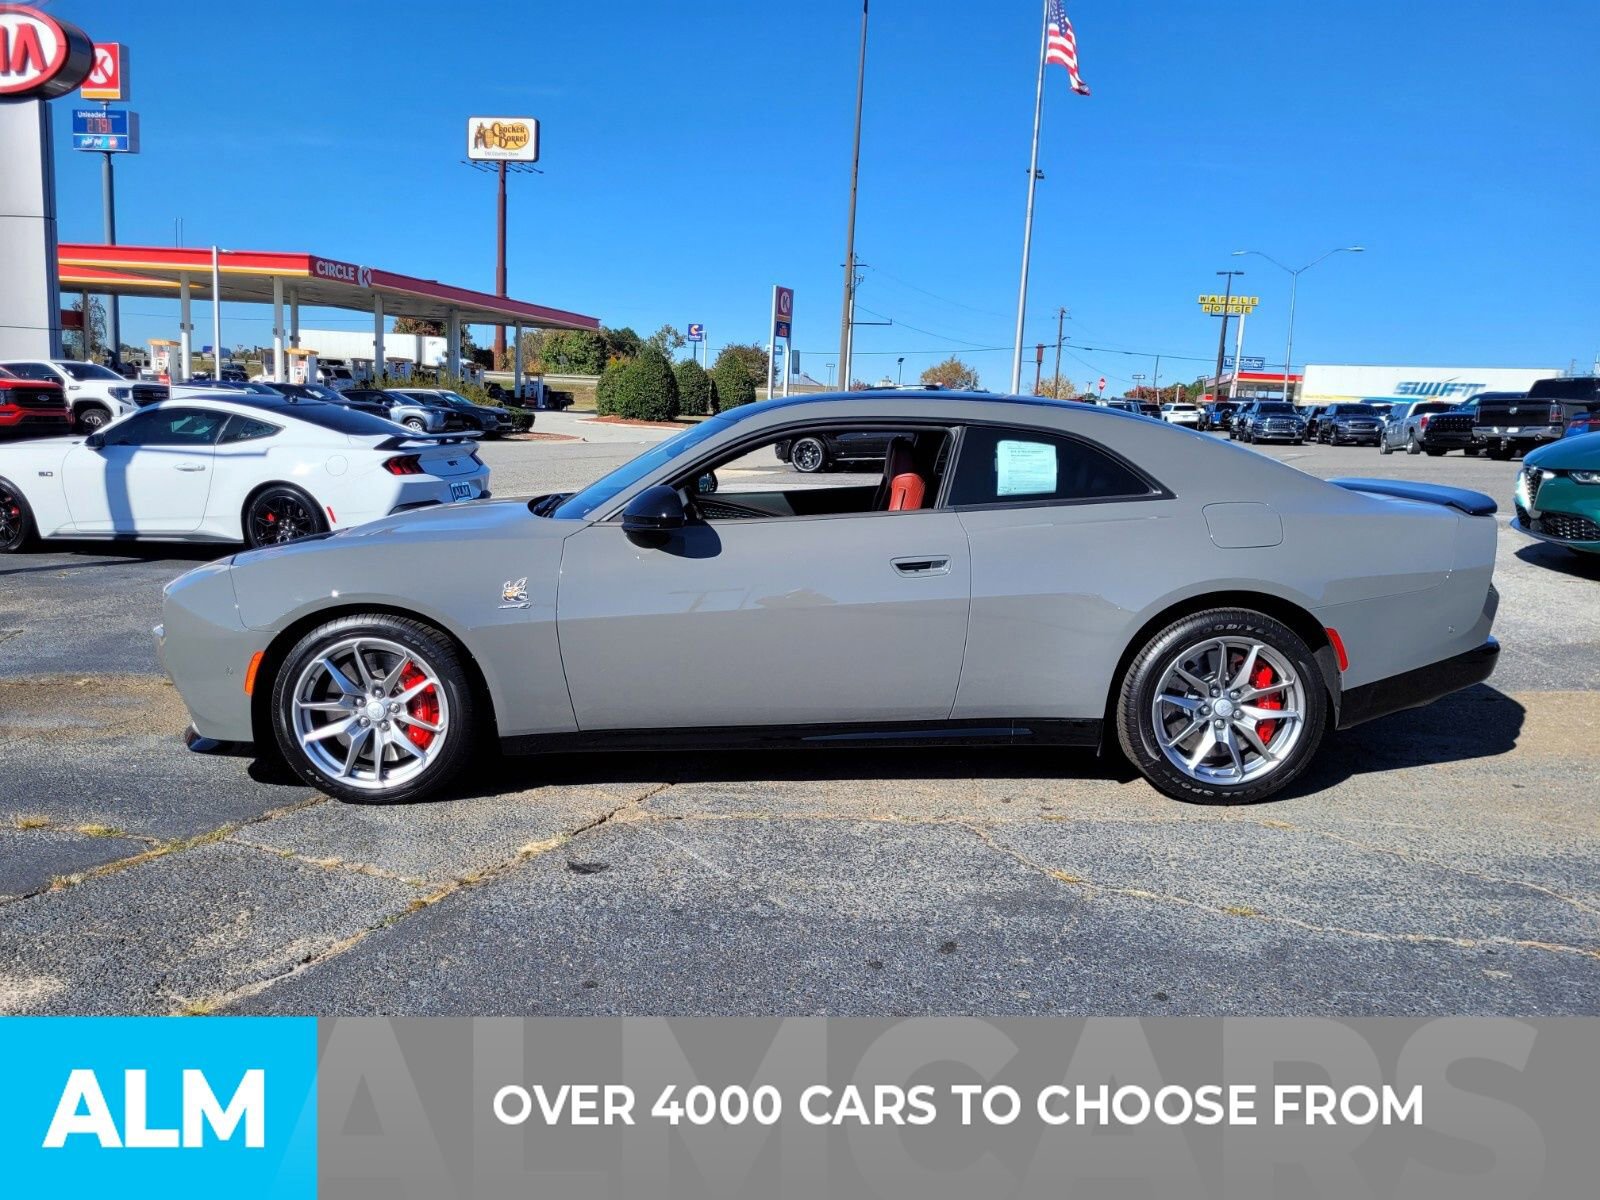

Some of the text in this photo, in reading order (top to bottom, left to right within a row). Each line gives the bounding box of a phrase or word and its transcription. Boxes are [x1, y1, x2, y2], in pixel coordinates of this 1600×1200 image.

[91, 55, 113, 80] K
[316, 260, 355, 281] CIRCLE
[1199, 296, 1258, 305] WAFFLE
[1393, 381, 1487, 397] SWIFT
